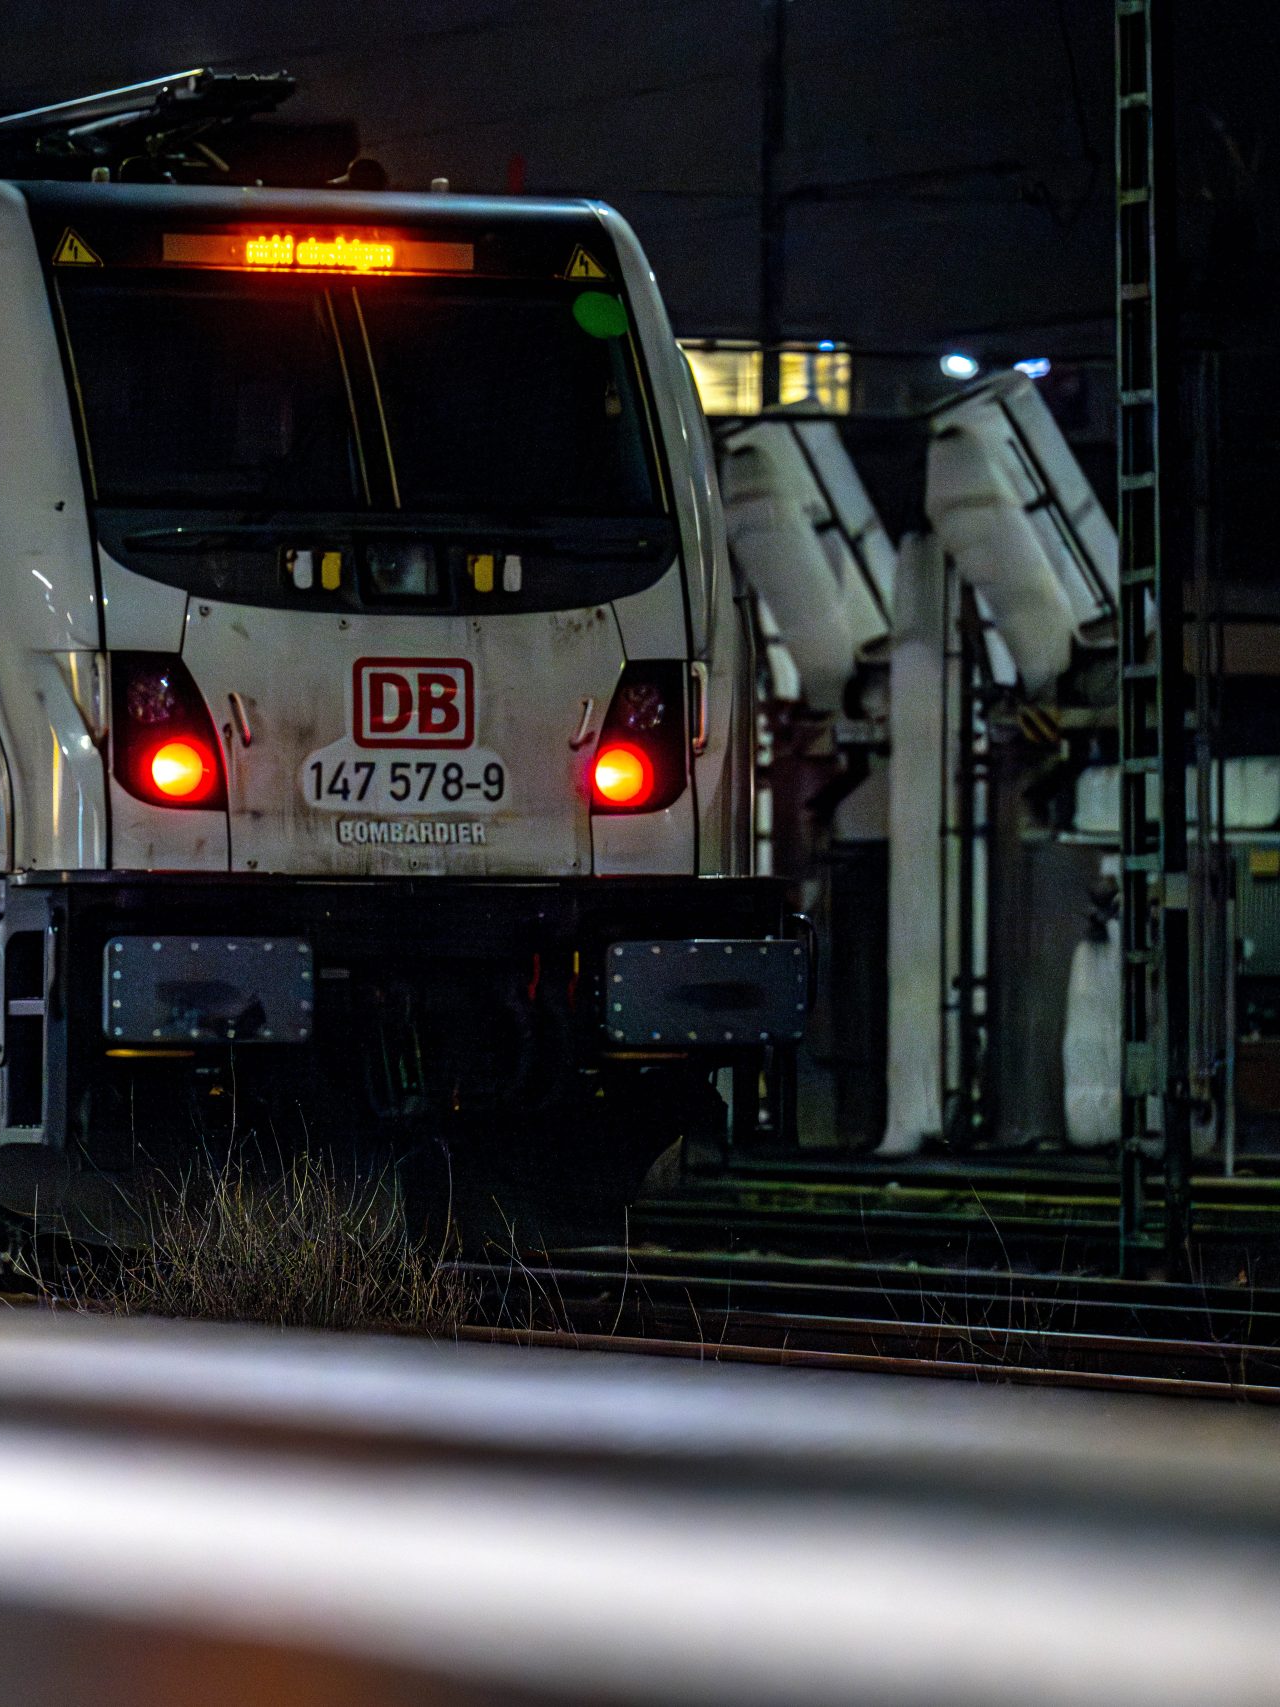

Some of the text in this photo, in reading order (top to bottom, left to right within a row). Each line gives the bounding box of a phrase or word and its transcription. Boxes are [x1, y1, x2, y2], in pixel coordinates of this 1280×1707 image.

[368, 672, 461, 734] DB
[310, 761, 504, 801] 147 578-9
[337, 820, 486, 844] BOMBARDIER
